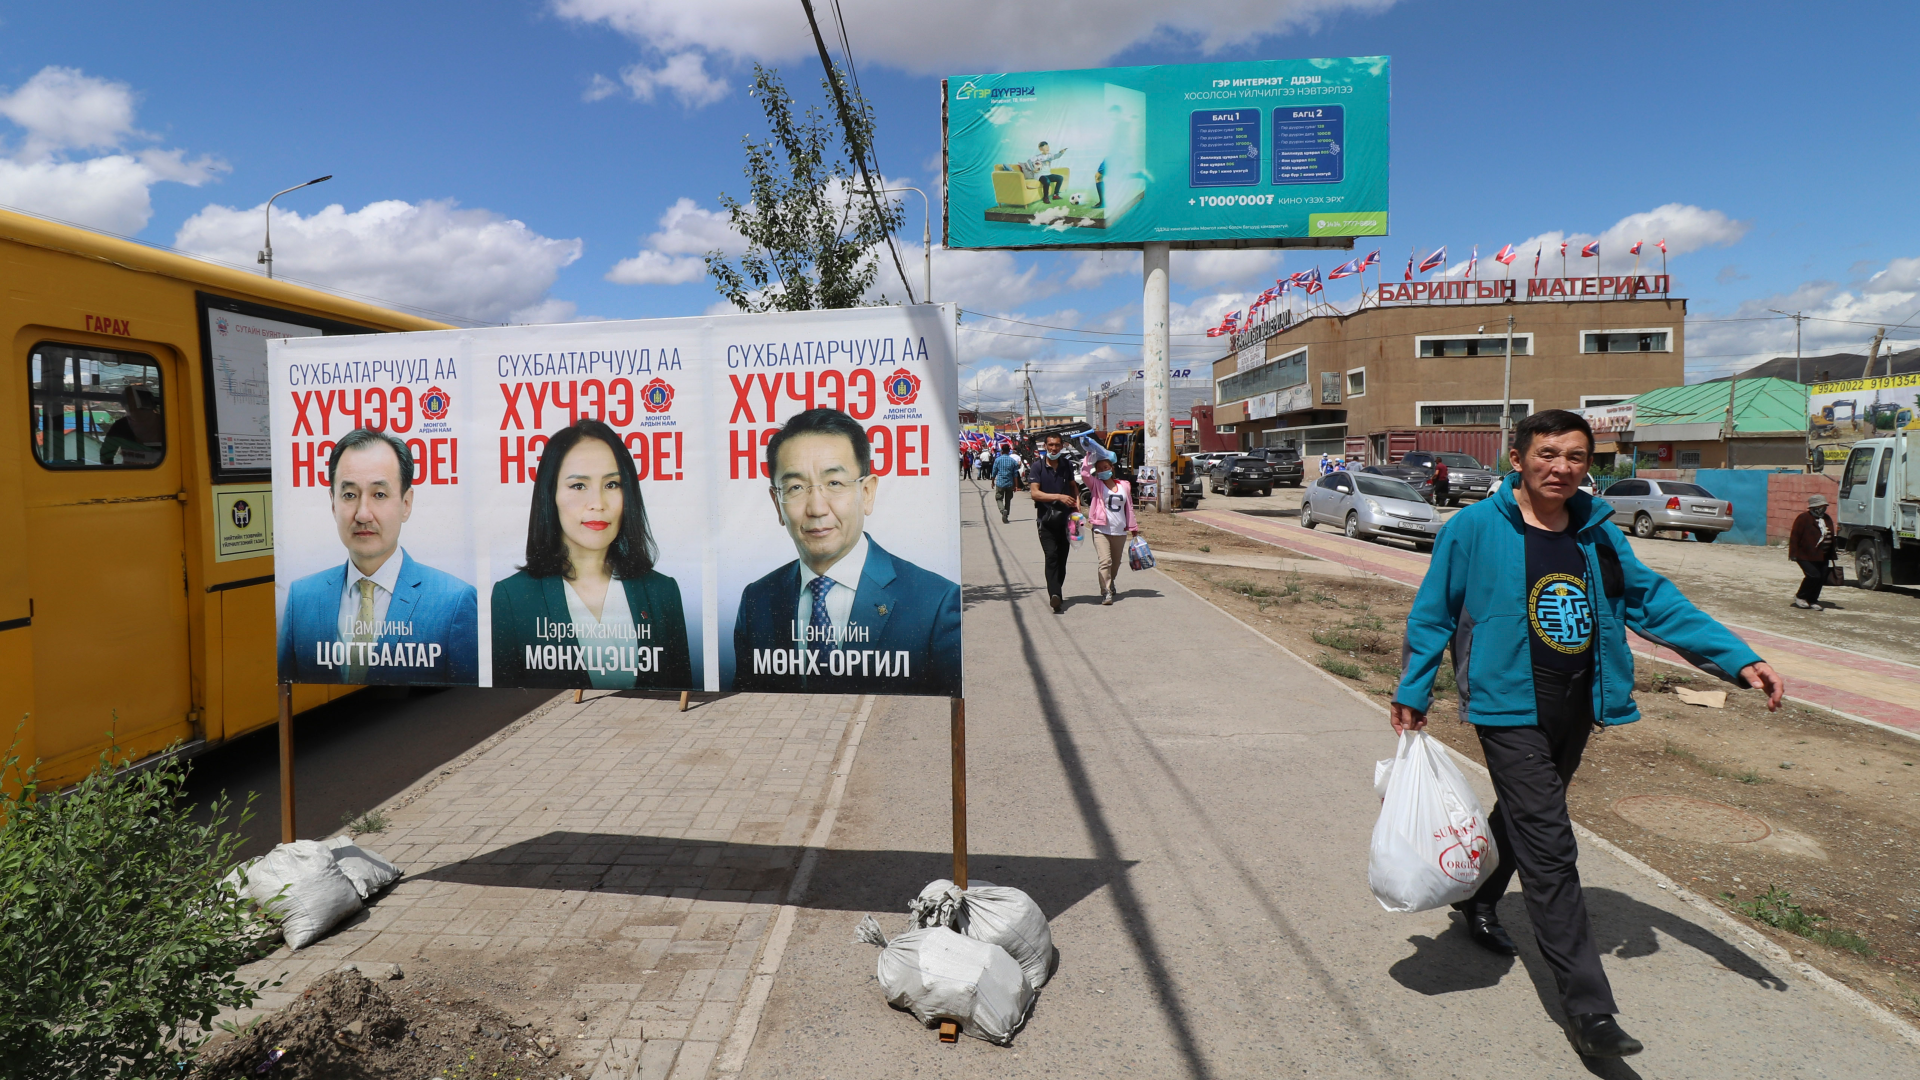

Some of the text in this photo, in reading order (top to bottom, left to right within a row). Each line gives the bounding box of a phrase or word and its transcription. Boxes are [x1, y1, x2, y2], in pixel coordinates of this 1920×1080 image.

[1184, 86, 1353, 100] ХОСОЛСОН ҮЙЛЧИЛГЭЭ НЭВТЭРЛЭЭ
[1212, 79, 1230, 88] ГЭР
[1232, 76, 1284, 87] ИНТЕРНЭТ
[1290, 76, 1322, 86] ДДЭШ
[1235, 112, 1240, 120] 1
[1316, 109, 1322, 117] 2
[1278, 197, 1302, 205] КИНО
[1303, 196, 1324, 204] ҮЗЭХ
[1379, 275, 1669, 300] БАРИЛГЫН МАТЕРИАЛ
[85, 314, 131, 336] ГАРАХ
[235, 324, 261, 336] СУТАЙН
[262, 328, 281, 339] БУЯНТ
[498, 347, 682, 378] СҮХБААТАРЧУУД АА
[727, 336, 929, 369] СҮХБААТАРЧУУД АА
[290, 357, 457, 386] СҮХБААТАРЧУУД АА
[729, 368, 876, 424] ХҮЧЭЭ
[1818, 380, 1864, 394] 99270022
[291, 386, 413, 436] ХҮЧЭЭ
[499, 378, 634, 430] ХҮЧЭЭ
[1108, 495, 1123, 512] C
[343, 615, 413, 638] Дамдины
[536, 616, 651, 642] Цэрэнжамцын
[791, 619, 870, 645] Цэндийн
[316, 641, 442, 670] ЦОГТБААТАР
[525, 644, 664, 676] МӨНХЦЭЦЭГ
[753, 648, 910, 677] МӨНХ-ОРГИЛ
